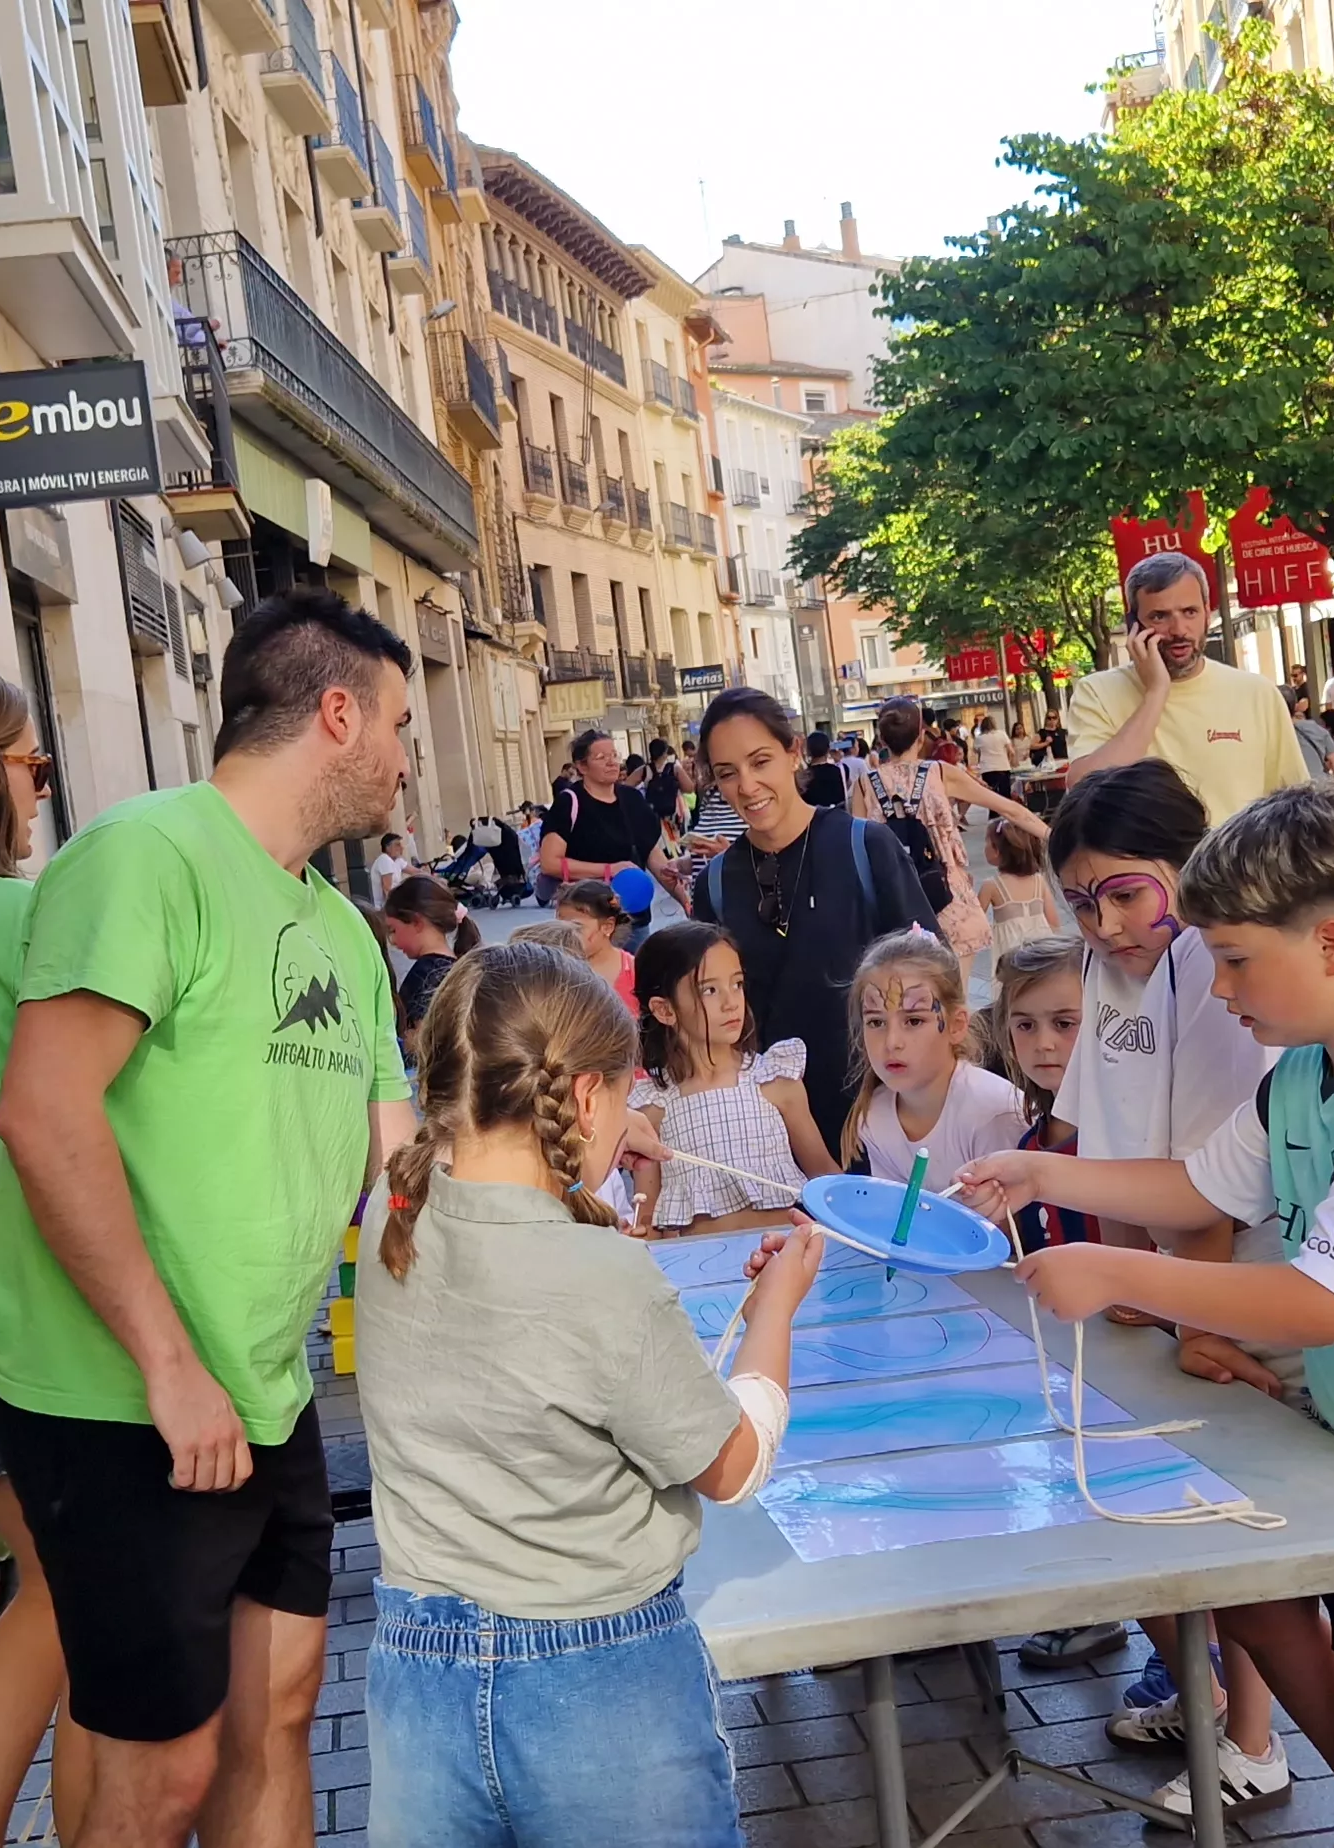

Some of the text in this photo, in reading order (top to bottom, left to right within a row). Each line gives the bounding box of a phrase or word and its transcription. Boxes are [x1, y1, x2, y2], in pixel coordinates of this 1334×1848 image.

[28, 473, 68, 491] MÓVIL
[74, 471, 89, 487] TV
[1242, 541, 1318, 558] DE CINE DE HUESCA
[1244, 561, 1323, 597] HIFF
[950, 655, 993, 675] HIFF
[683, 674, 723, 687] Arenas
[912, 771, 927, 800] BIMBA
